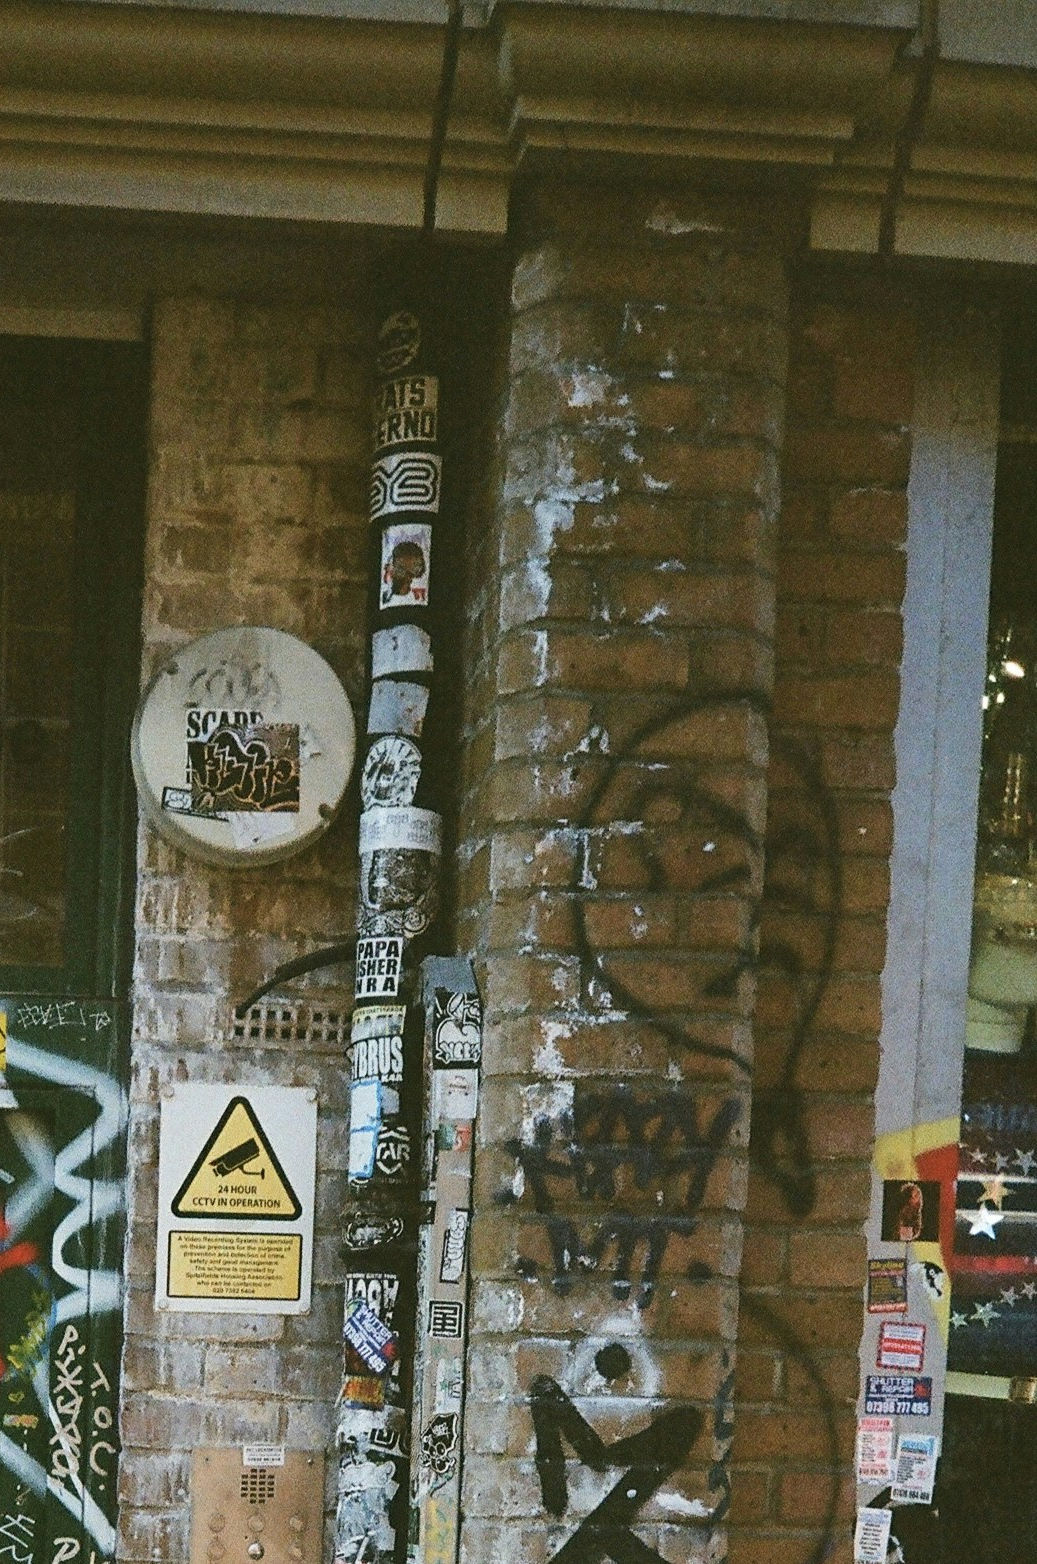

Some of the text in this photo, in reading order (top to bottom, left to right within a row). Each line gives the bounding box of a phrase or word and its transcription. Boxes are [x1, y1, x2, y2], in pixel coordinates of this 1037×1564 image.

[358, 940, 400, 961] PAPA
[217, 1184, 258, 1195] 24 HOUR
[192, 1197, 282, 1209] CCTV IN OPERATION
